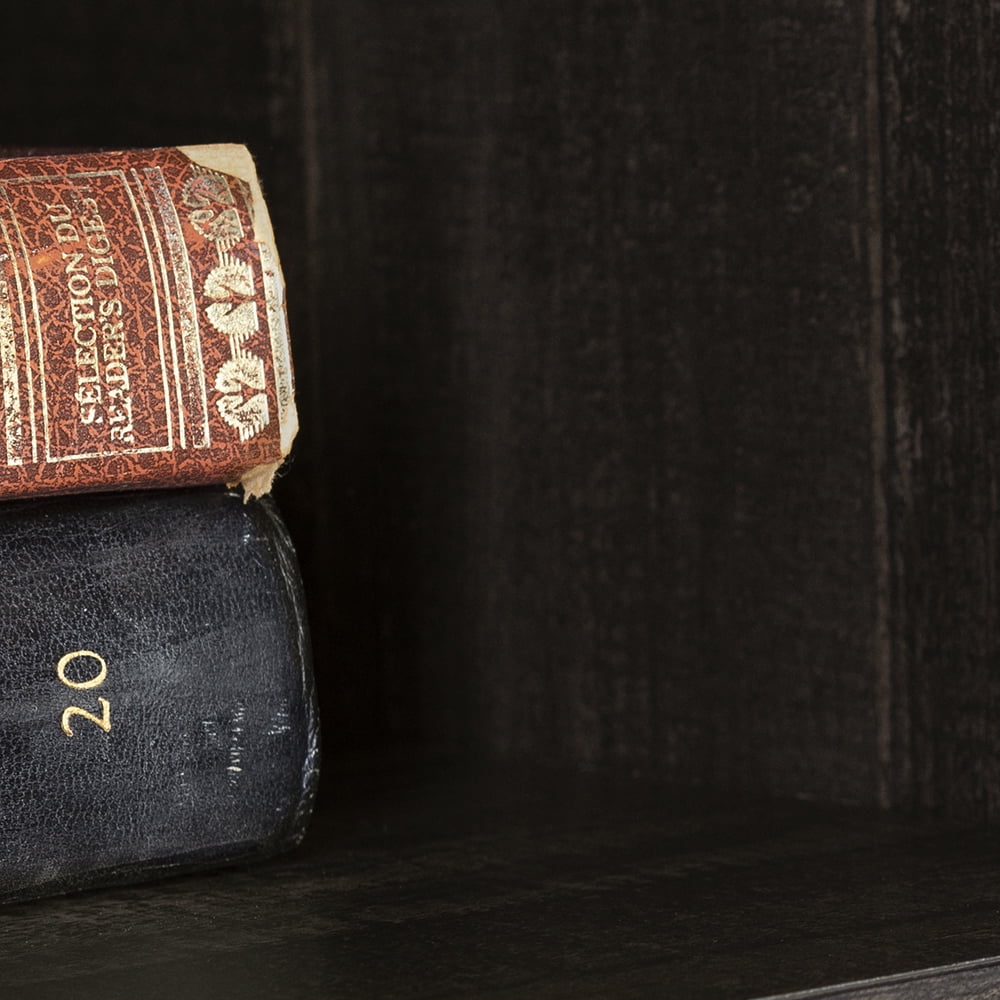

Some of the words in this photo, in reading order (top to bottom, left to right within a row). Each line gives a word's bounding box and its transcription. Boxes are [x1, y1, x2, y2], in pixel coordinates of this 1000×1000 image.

[46, 202, 80, 244] DU
[99, 299, 135, 444] READER'S
[57, 650, 112, 737] 20
